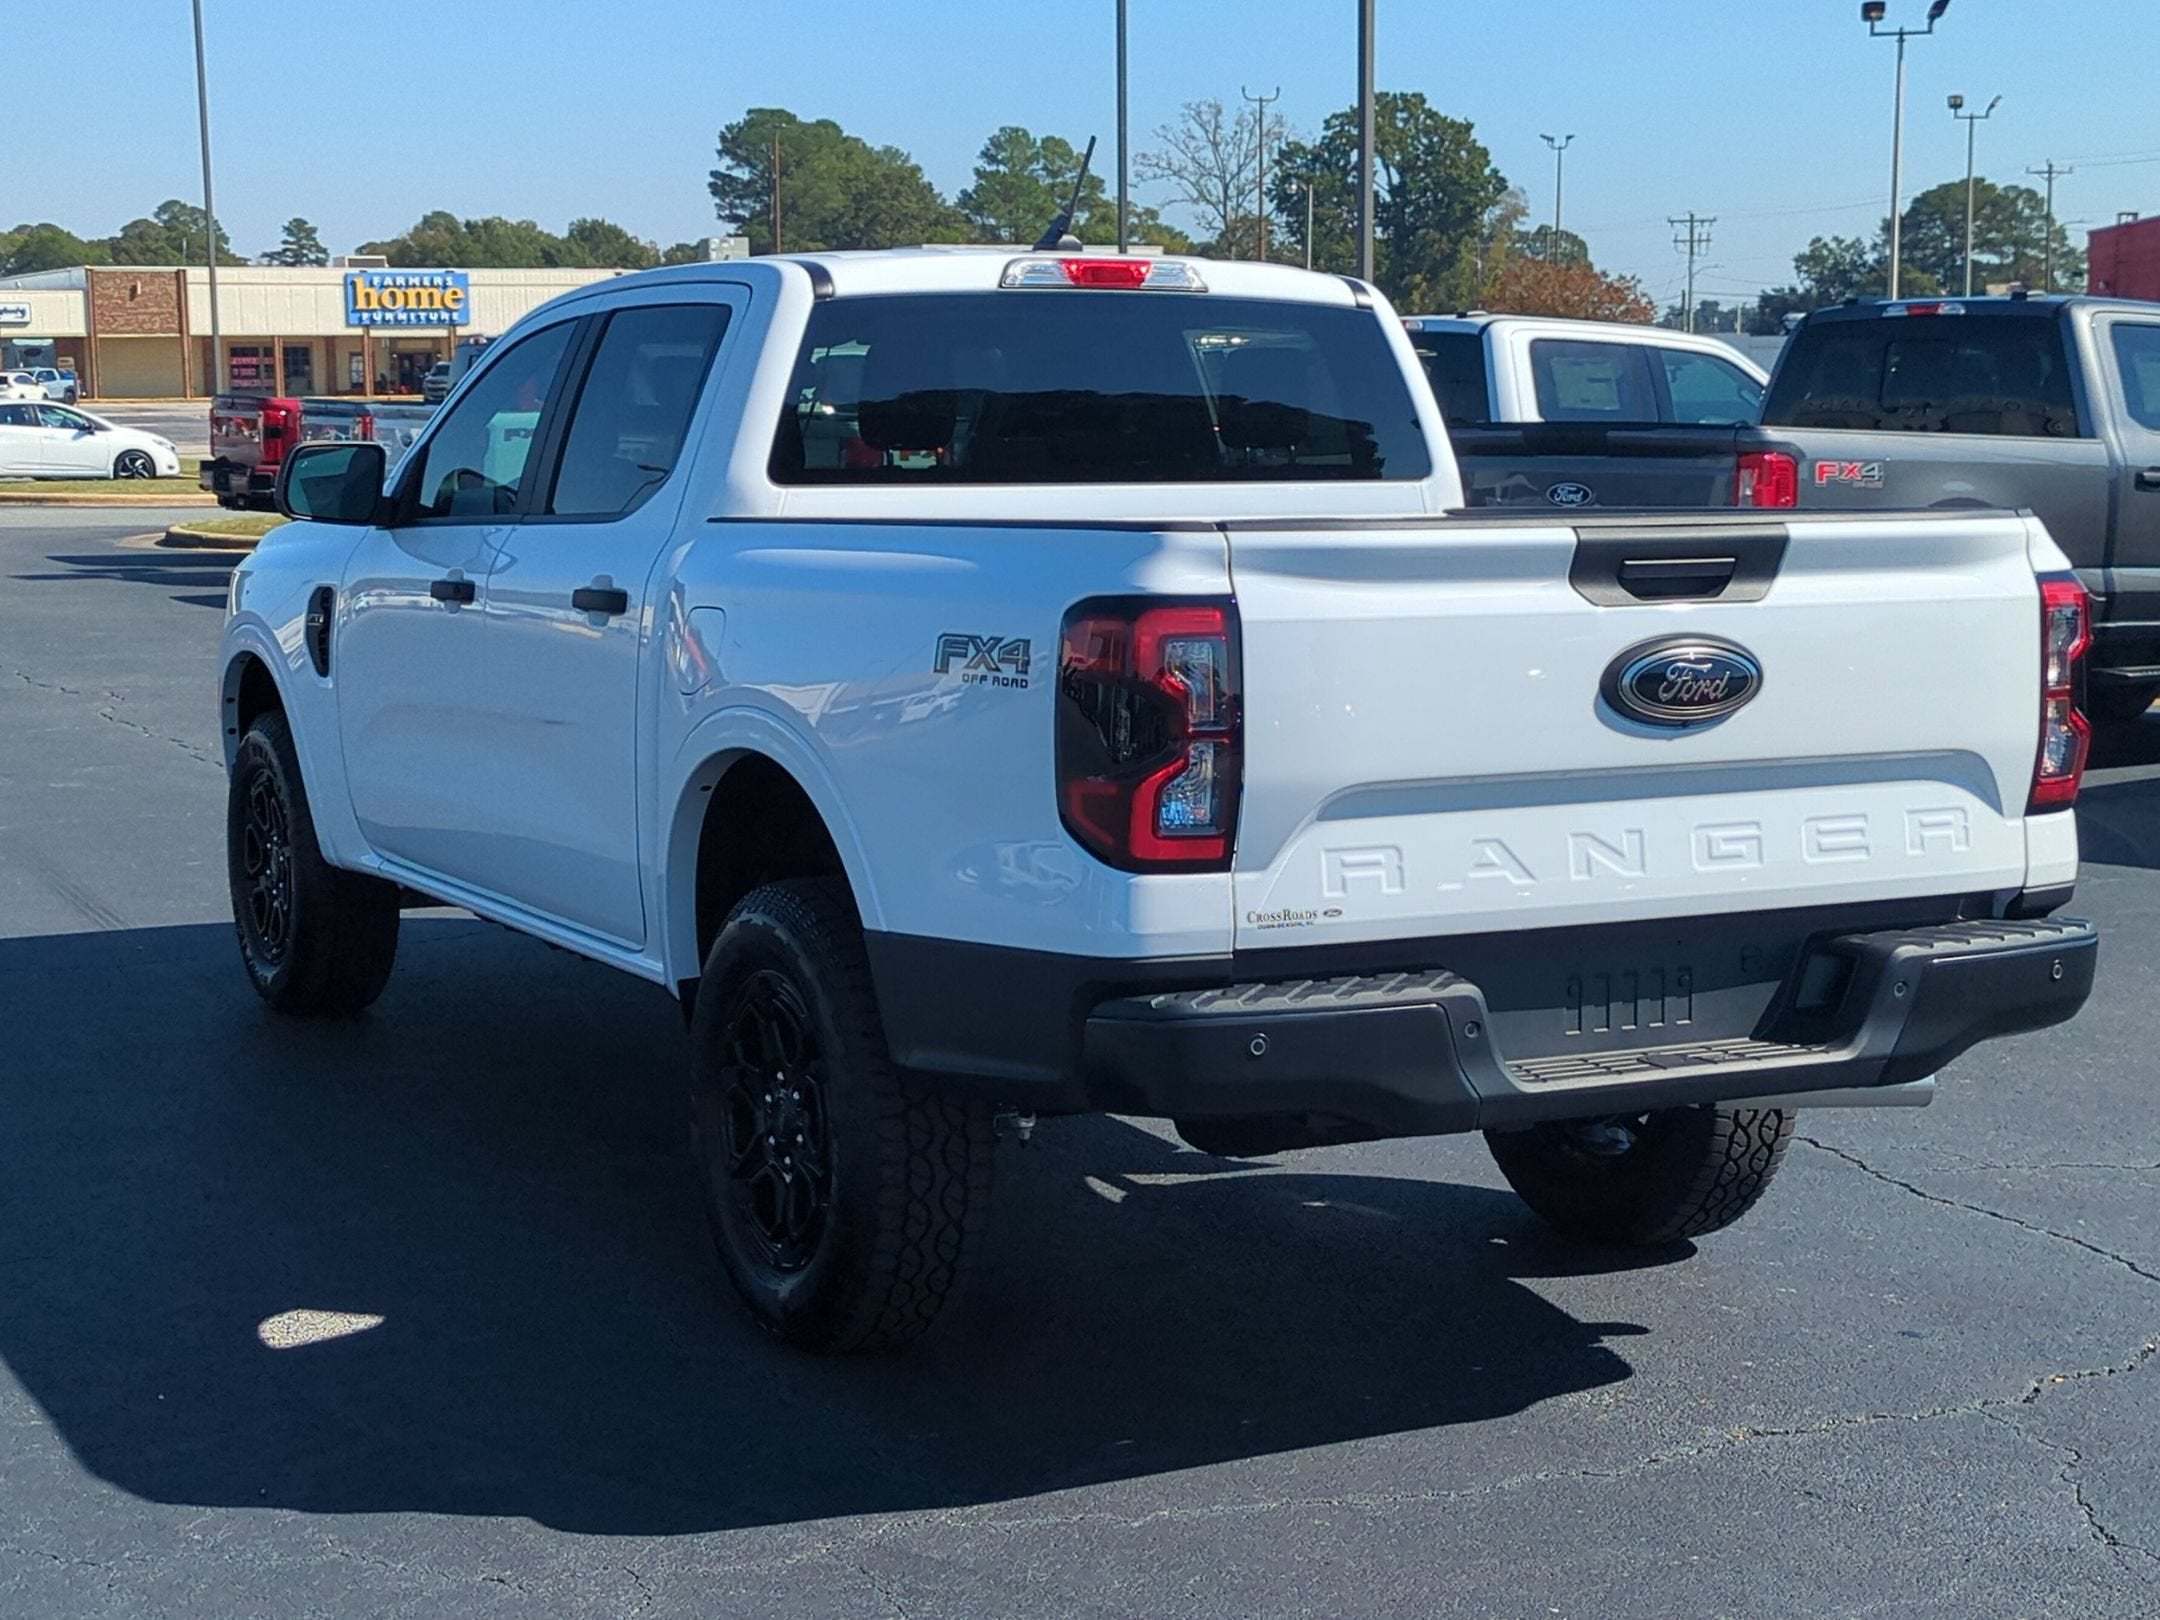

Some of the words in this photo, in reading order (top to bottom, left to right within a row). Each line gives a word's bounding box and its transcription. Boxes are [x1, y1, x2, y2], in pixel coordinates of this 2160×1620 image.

[353, 276, 465, 310] home
[372, 276, 454, 286] FARMERS
[361, 312, 460, 322] FURNITURE
[1815, 461, 1884, 485] FX4
[1554, 485, 1584, 502] Ford
[933, 632, 1032, 675] FX4
[962, 673, 988, 685] OFF
[992, 676, 1029, 689] ROAD
[1658, 662, 1731, 702] Ford
[1321, 807, 1969, 898] RANGER
